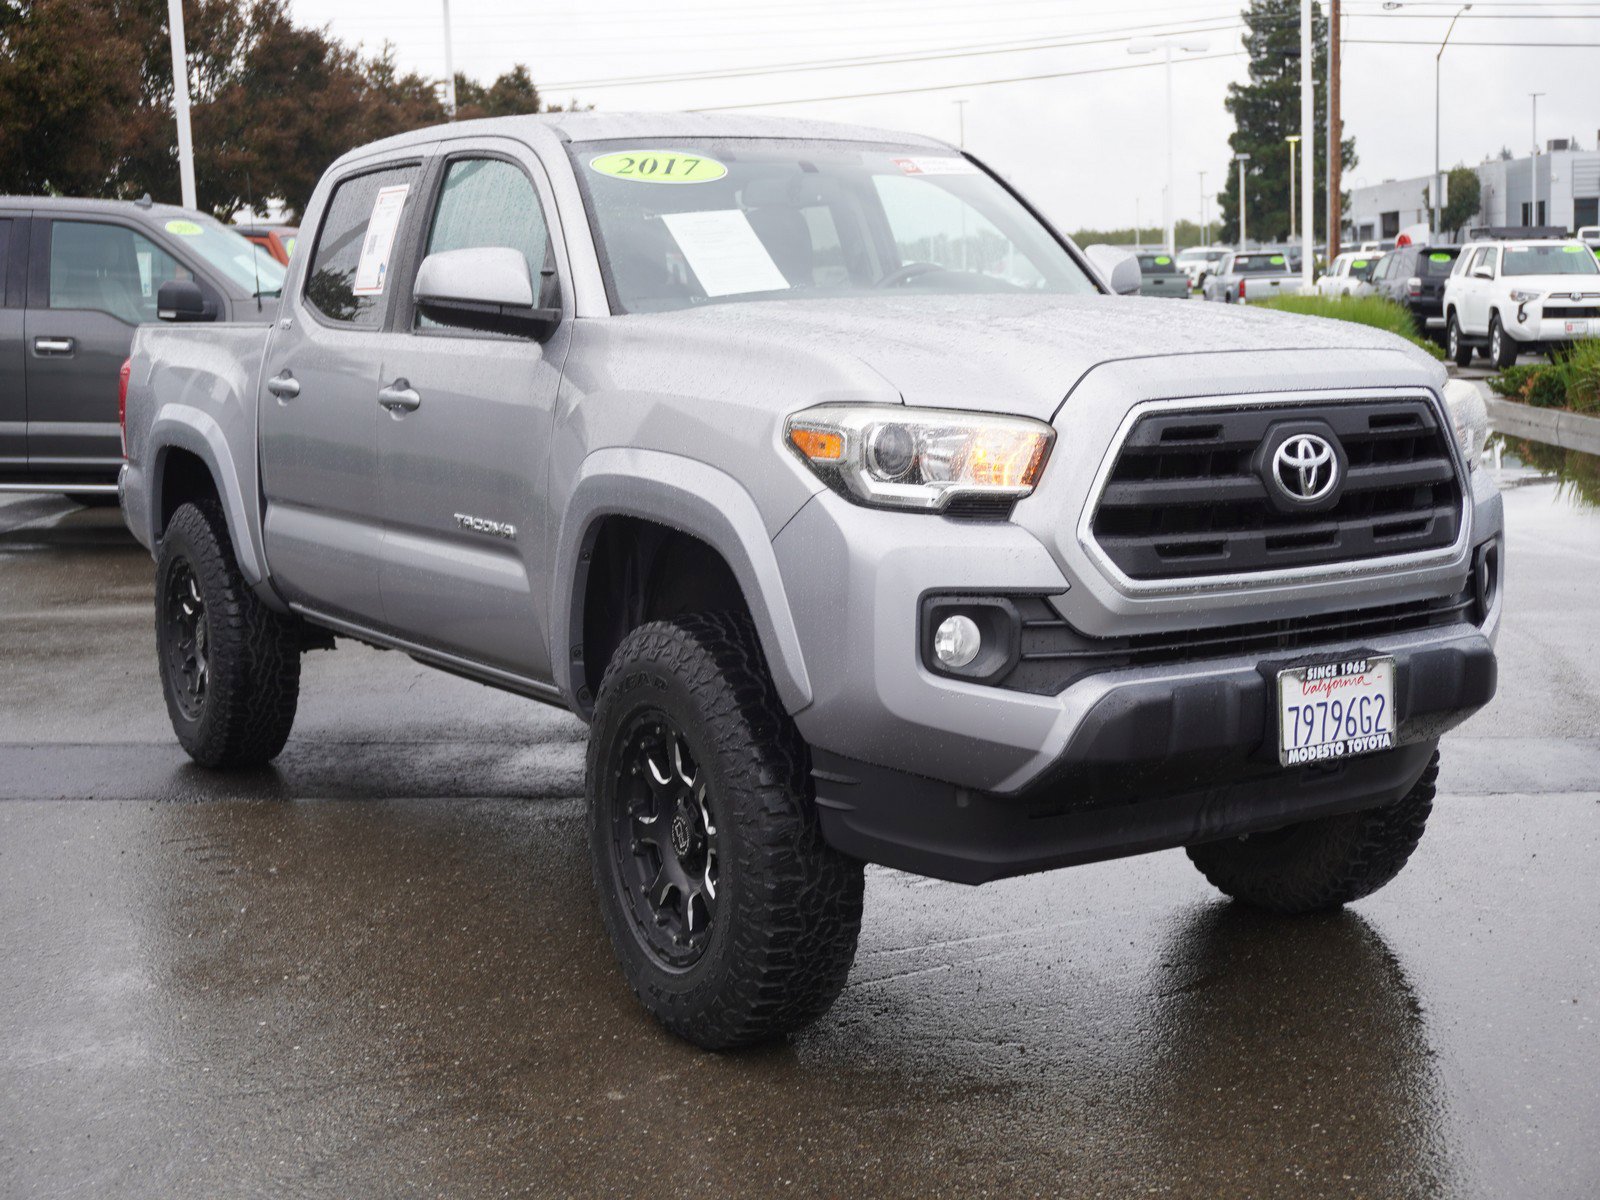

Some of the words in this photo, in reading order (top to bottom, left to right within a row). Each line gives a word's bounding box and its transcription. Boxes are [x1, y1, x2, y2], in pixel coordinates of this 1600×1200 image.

[617, 157, 701, 176] 2017
[453, 513, 517, 535] TACOMA
[1306, 666, 1337, 681] SINCE
[1341, 660, 1367, 677] 1965
[1302, 674, 1372, 698] California
[1288, 693, 1387, 747] 79796G2
[1288, 741, 1344, 764] MODESTO
[1347, 733, 1391, 754] TOYOTA
